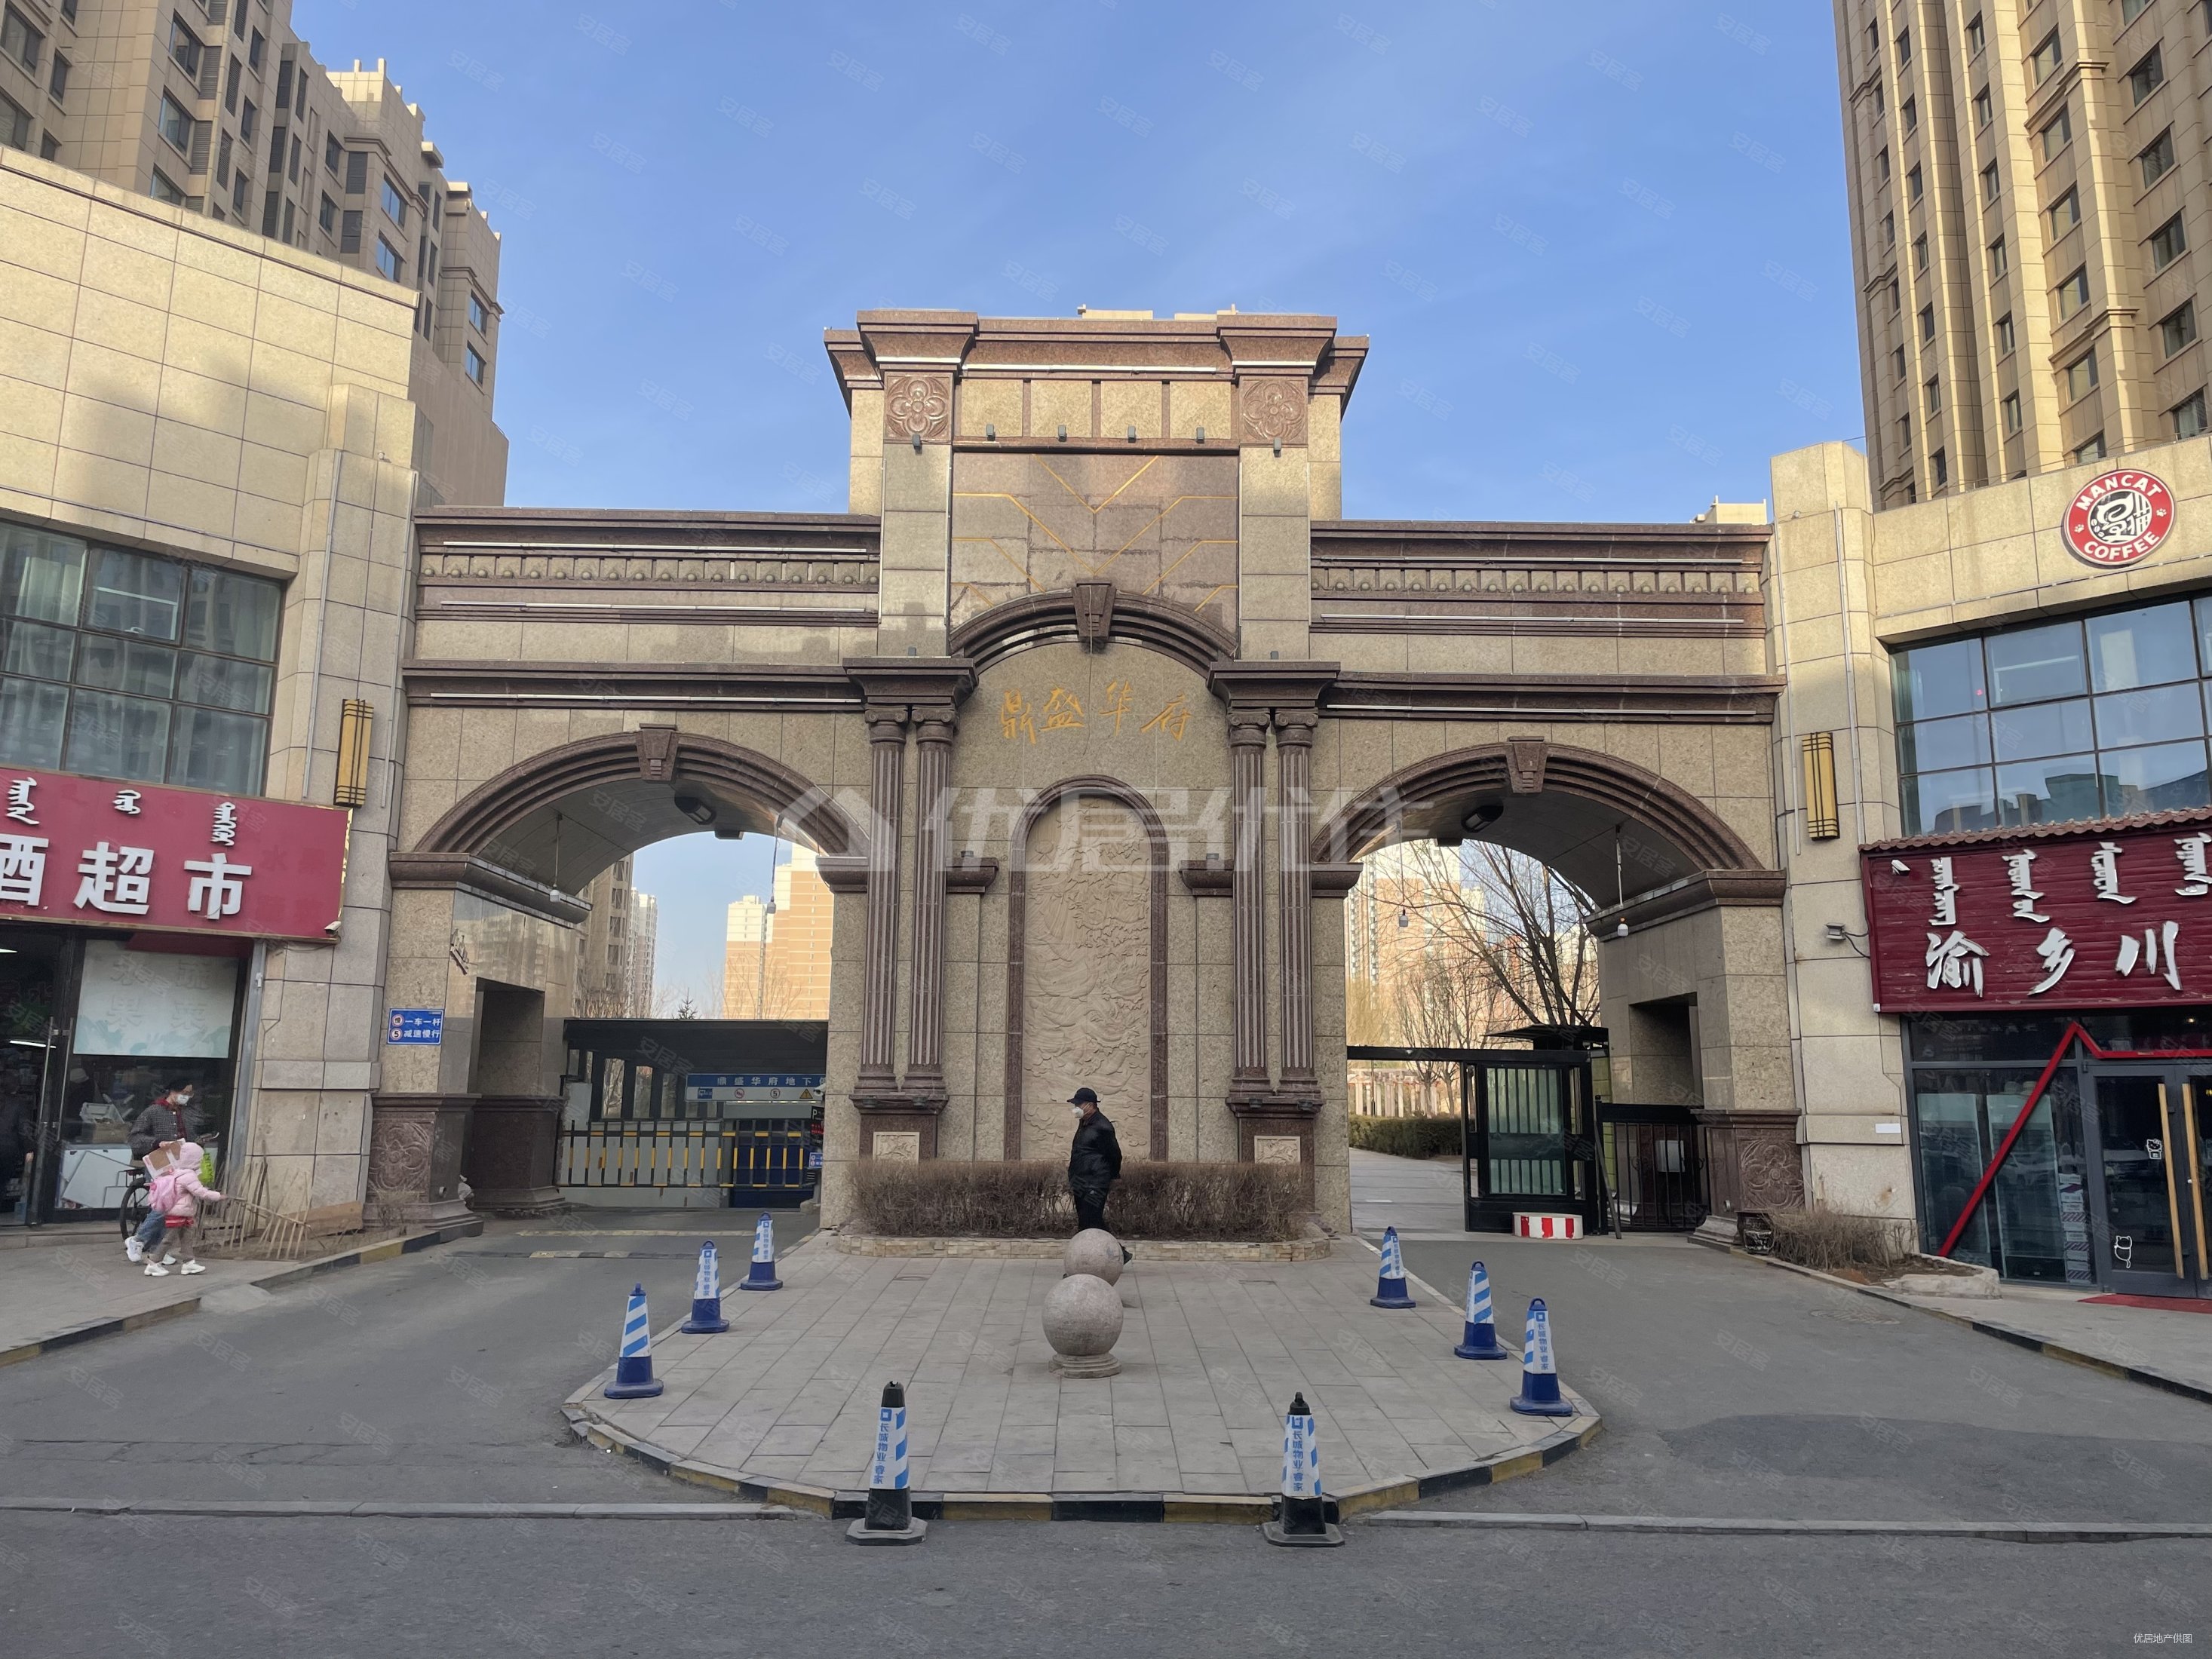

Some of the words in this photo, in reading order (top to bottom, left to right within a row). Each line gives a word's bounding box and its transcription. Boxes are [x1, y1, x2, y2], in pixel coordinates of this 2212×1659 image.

[2075, 474, 2162, 511] MANCAT
[2084, 531, 2159, 560] COFFEE
[1001, 680, 1192, 745] 鼎盛华府
[1925, 921, 2183, 998] 渝乡川
[403, 1029, 440, 1038] 减速慢行
[405, 1017, 440, 1026] 一车一杆
